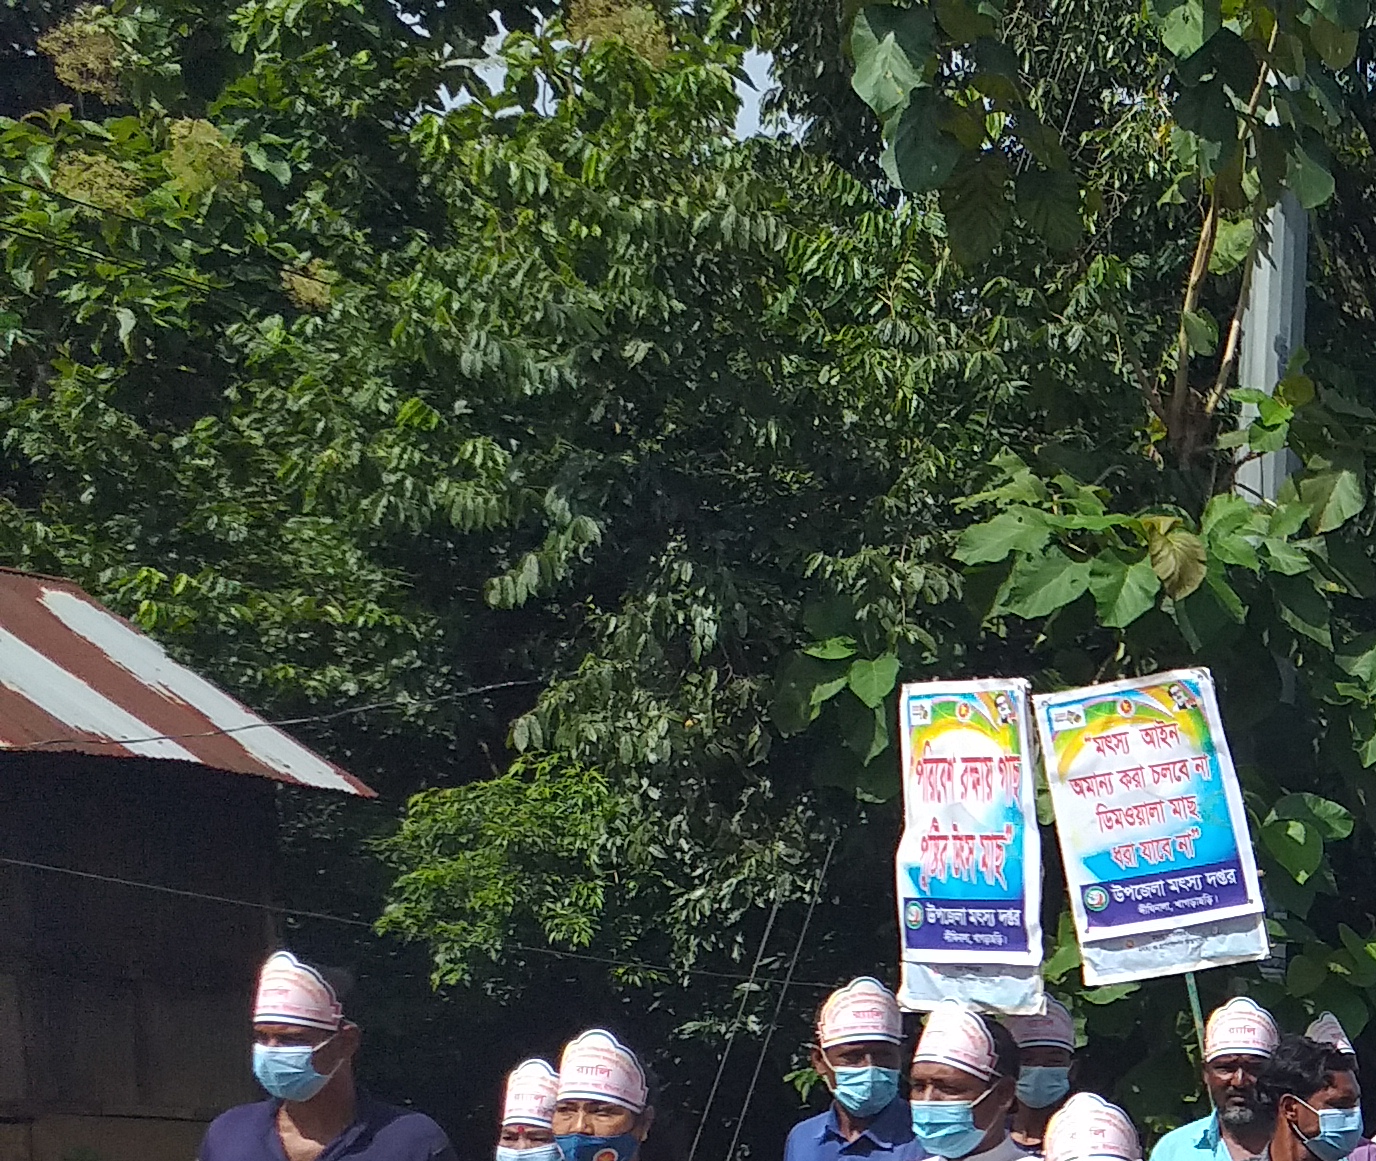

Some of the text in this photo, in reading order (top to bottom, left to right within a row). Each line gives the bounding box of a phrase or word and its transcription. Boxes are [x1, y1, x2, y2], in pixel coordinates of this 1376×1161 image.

[1142, 720, 1181, 750] আইন
[1070, 754, 1211, 798] অমান্য করা চলবে না
[1096, 795, 1200, 832] ডিমওয়ালা মাছ
[1110, 844, 1138, 870] ধরা
[1140, 838, 1174, 863] যাবে
[1110, 868, 1237, 902] উপজেলা মৎস্য দপ্তর
